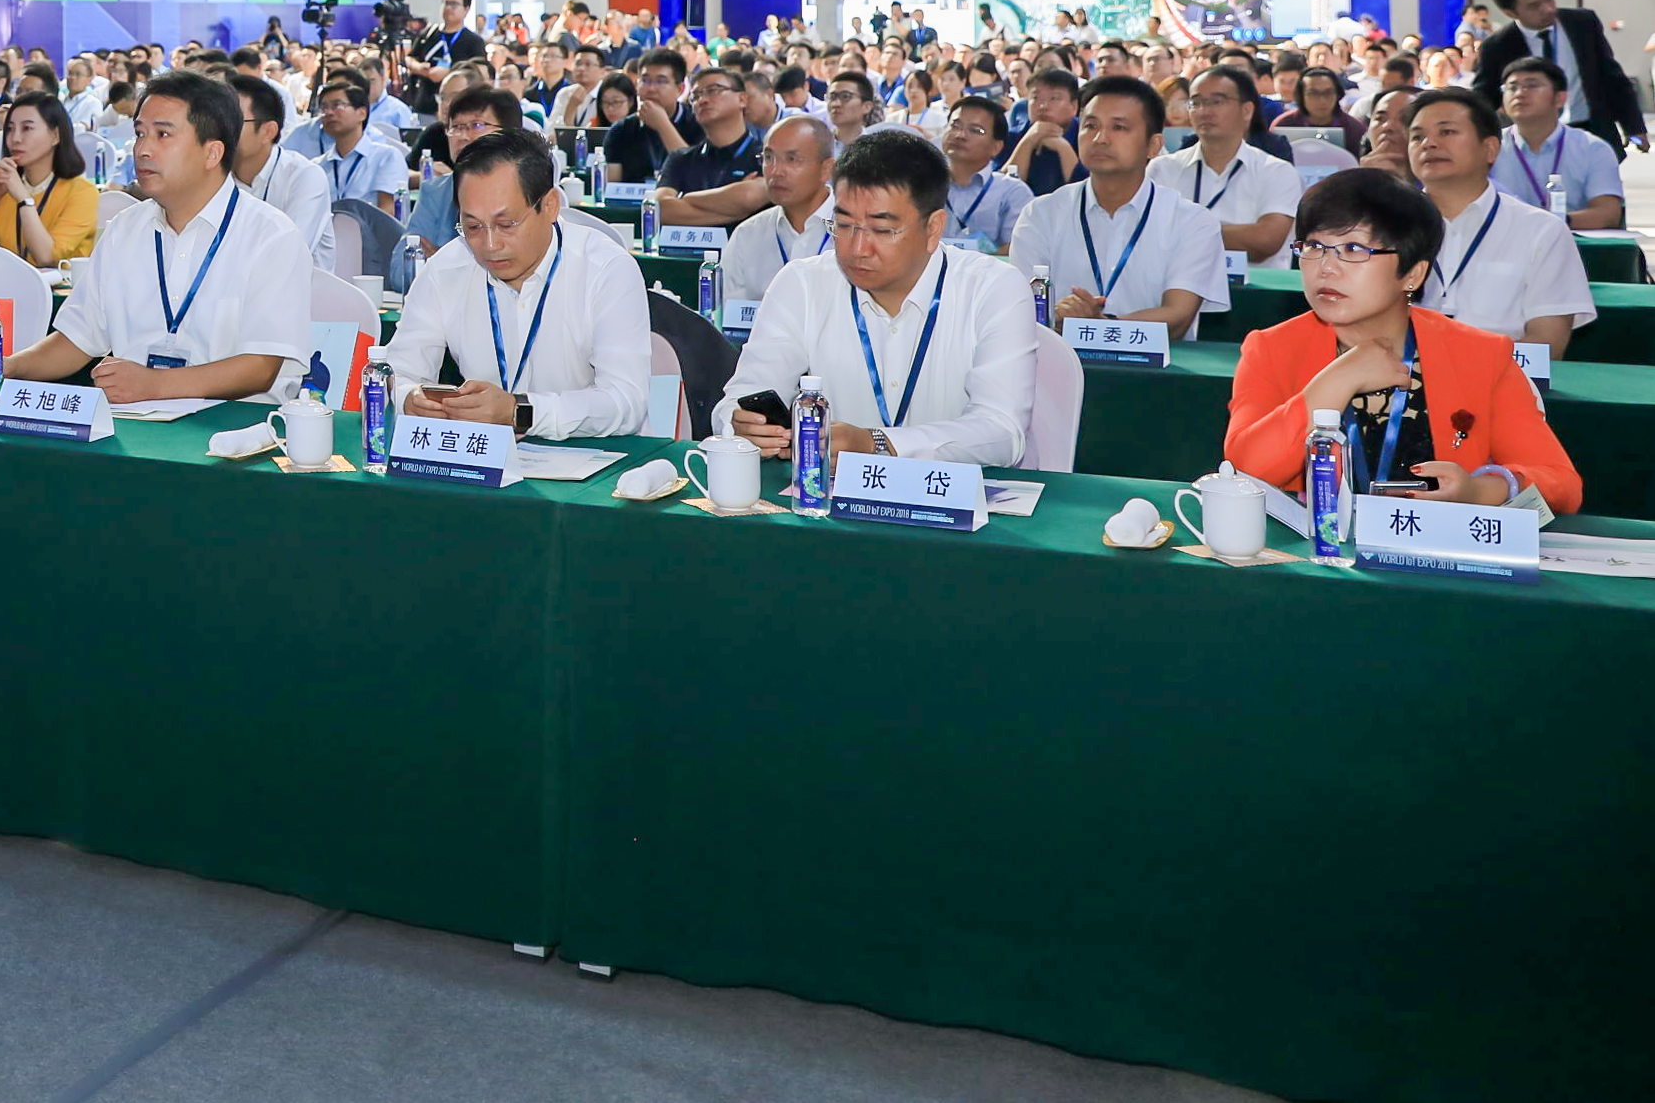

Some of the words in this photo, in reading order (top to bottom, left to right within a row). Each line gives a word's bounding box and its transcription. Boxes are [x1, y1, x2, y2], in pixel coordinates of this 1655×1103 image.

[670, 230, 713, 243] 商务局
[1078, 325, 1148, 345] 市委办
[12, 388, 82, 415] 朱旭峰
[410, 426, 490, 456] 林宣雄
[862, 464, 951, 497] 张岱
[849, 503, 871, 514] WORLD
[880, 507, 895, 517] EXPO
[895, 509, 910, 519] 2018
[1390, 508, 1502, 545] 林翎
[1377, 553, 1404, 565] WORLD
[1405, 555, 1416, 566] IoT
[1417, 556, 1436, 568] EXPO
[1437, 560, 1455, 570] 2018
